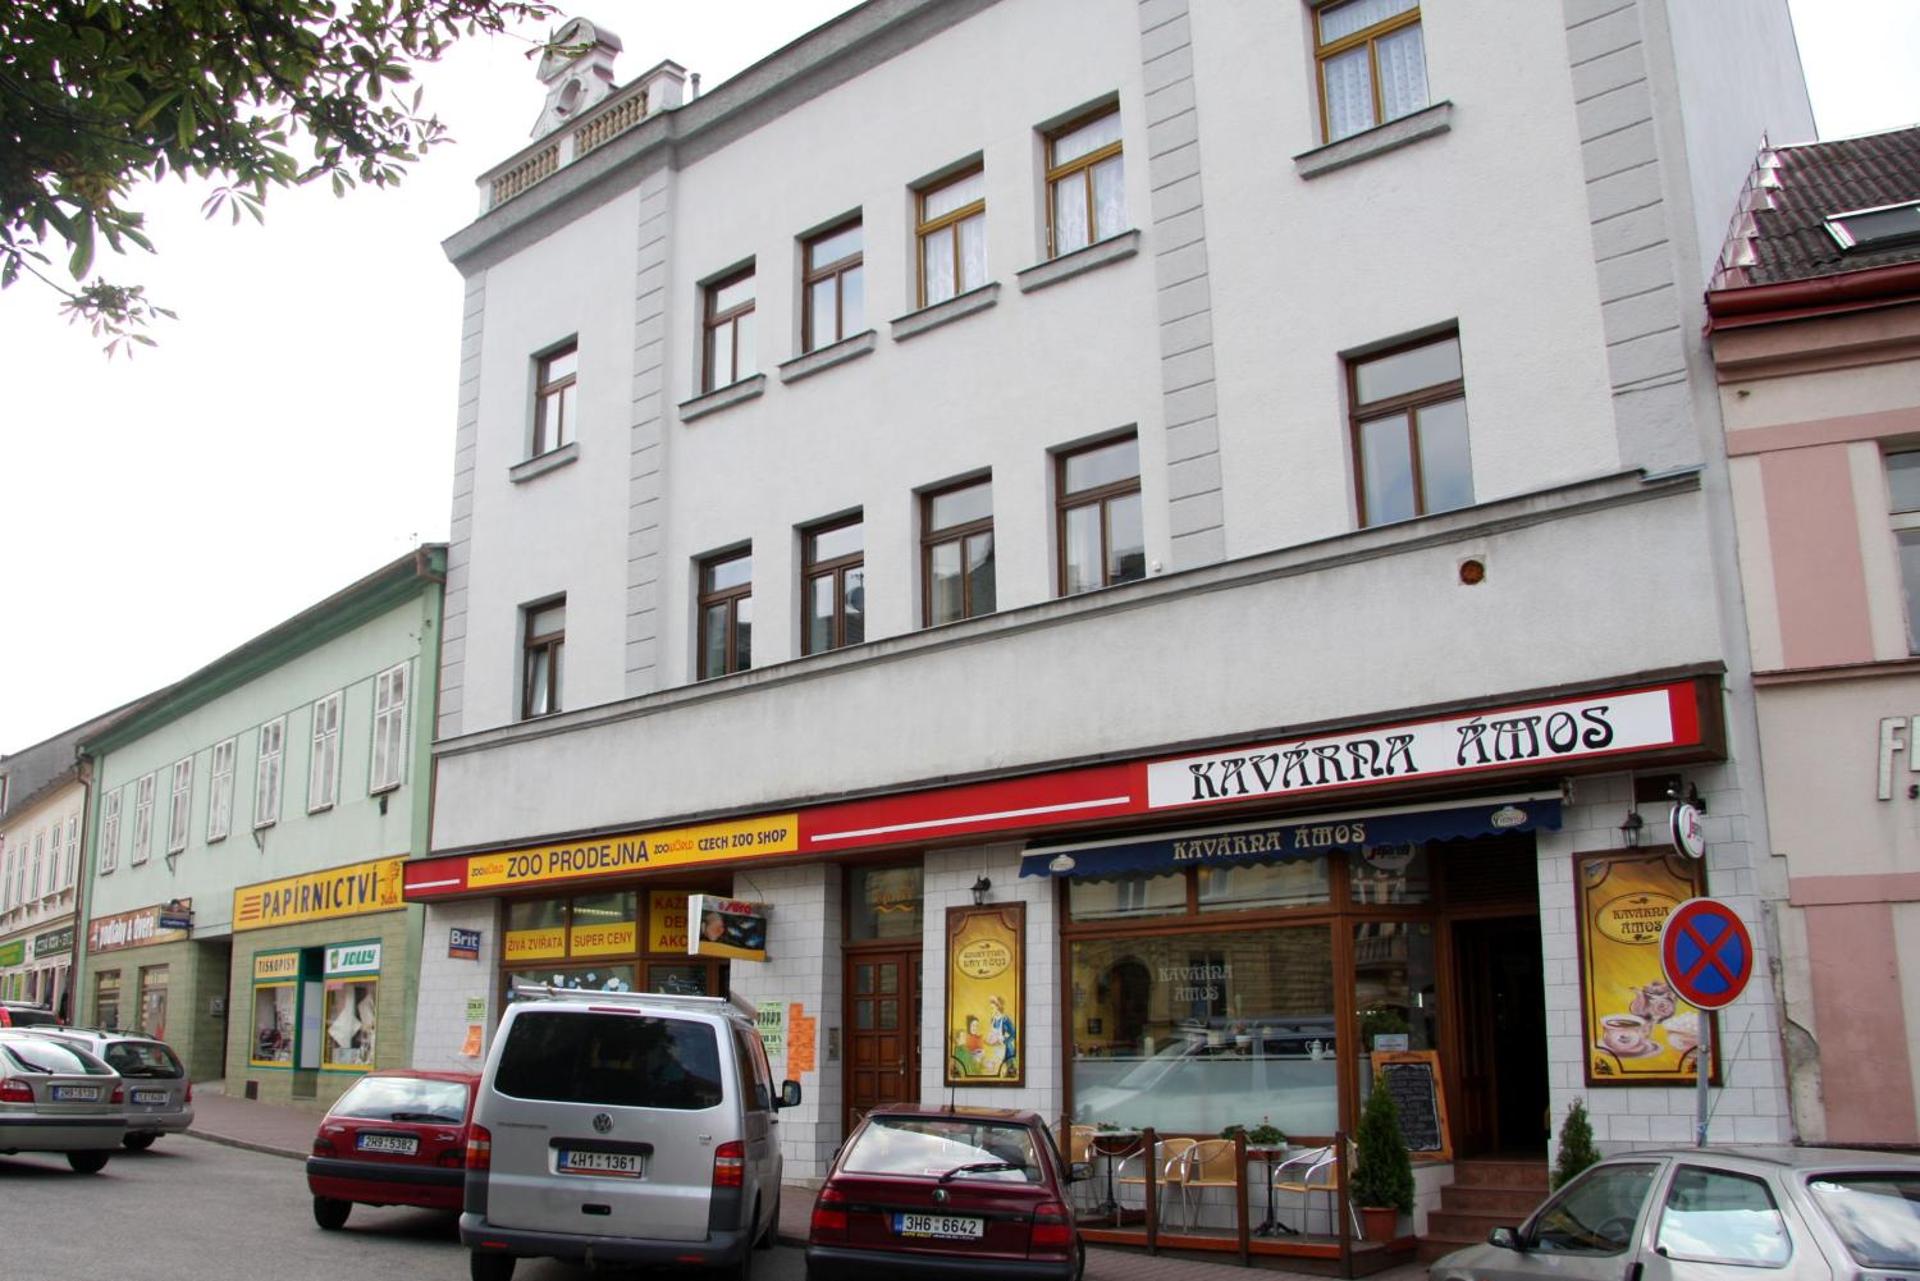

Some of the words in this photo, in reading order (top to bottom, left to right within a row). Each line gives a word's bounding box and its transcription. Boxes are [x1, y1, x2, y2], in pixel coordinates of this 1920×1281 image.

[1188, 734, 1419, 800] KAVÁRNA
[1456, 705, 1614, 766] ÁMOS
[506, 853, 543, 878] ZOO
[549, 840, 649, 873] PRODEJNA
[698, 836, 728, 851] CZECH
[731, 833, 754, 848] ZOO
[757, 829, 787, 845] SHOP
[1173, 831, 1282, 860] KAVÁRNA
[262, 863, 379, 919] PAPÍRNICTVÍ
[451, 930, 478, 947] Brit
[573, 933, 604, 948] SUPER
[607, 930, 632, 945] CENY
[257, 957, 296, 974] TISKOPISY
[570, 1152, 594, 1168] 4H1
[605, 1155, 636, 1171] 1361
[906, 1216, 932, 1231] 3H6
[942, 1218, 977, 1235] 6642
